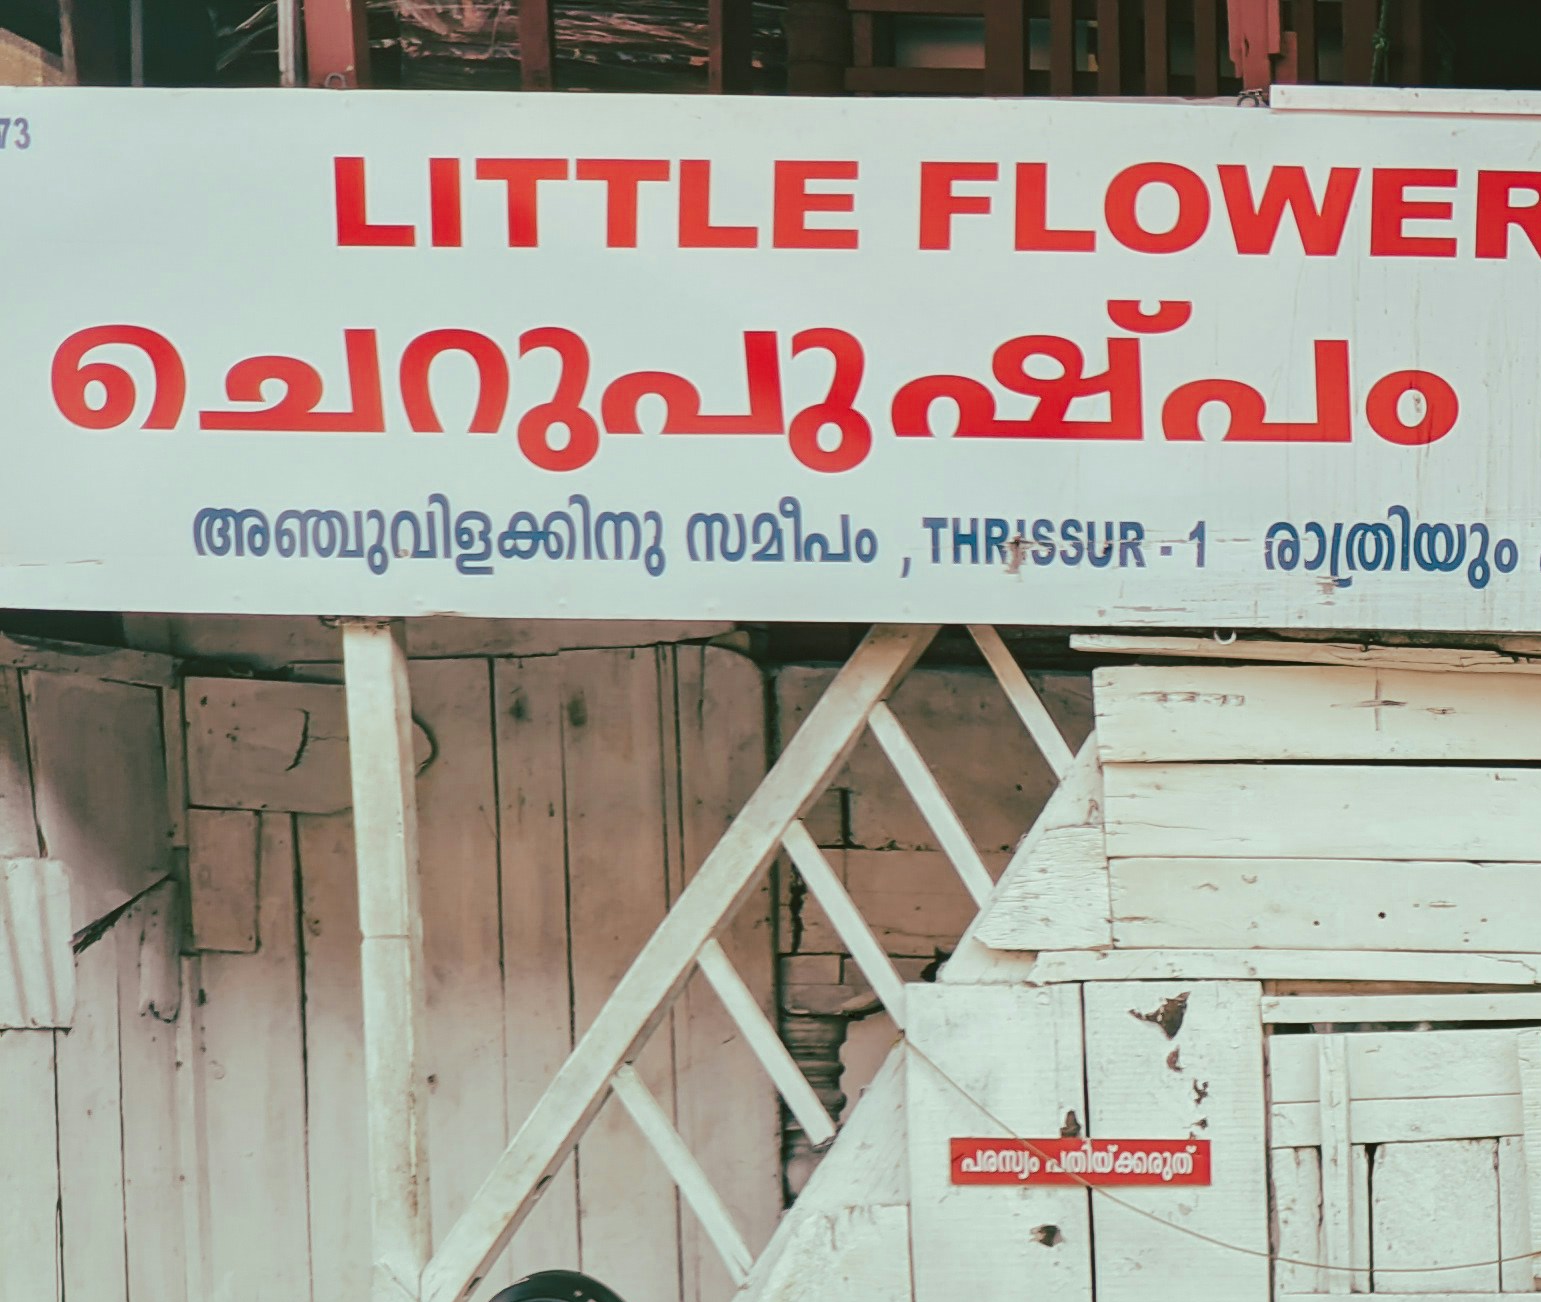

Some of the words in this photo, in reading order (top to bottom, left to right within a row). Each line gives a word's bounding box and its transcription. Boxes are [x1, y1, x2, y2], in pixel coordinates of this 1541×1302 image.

[333, 157, 860, 249] LITTLE
[685, 496, 879, 564] സമീപം
[1264, 504, 1520, 590] രാത്രിയും
[960, 1149, 1041, 1181] പരസ്യം
